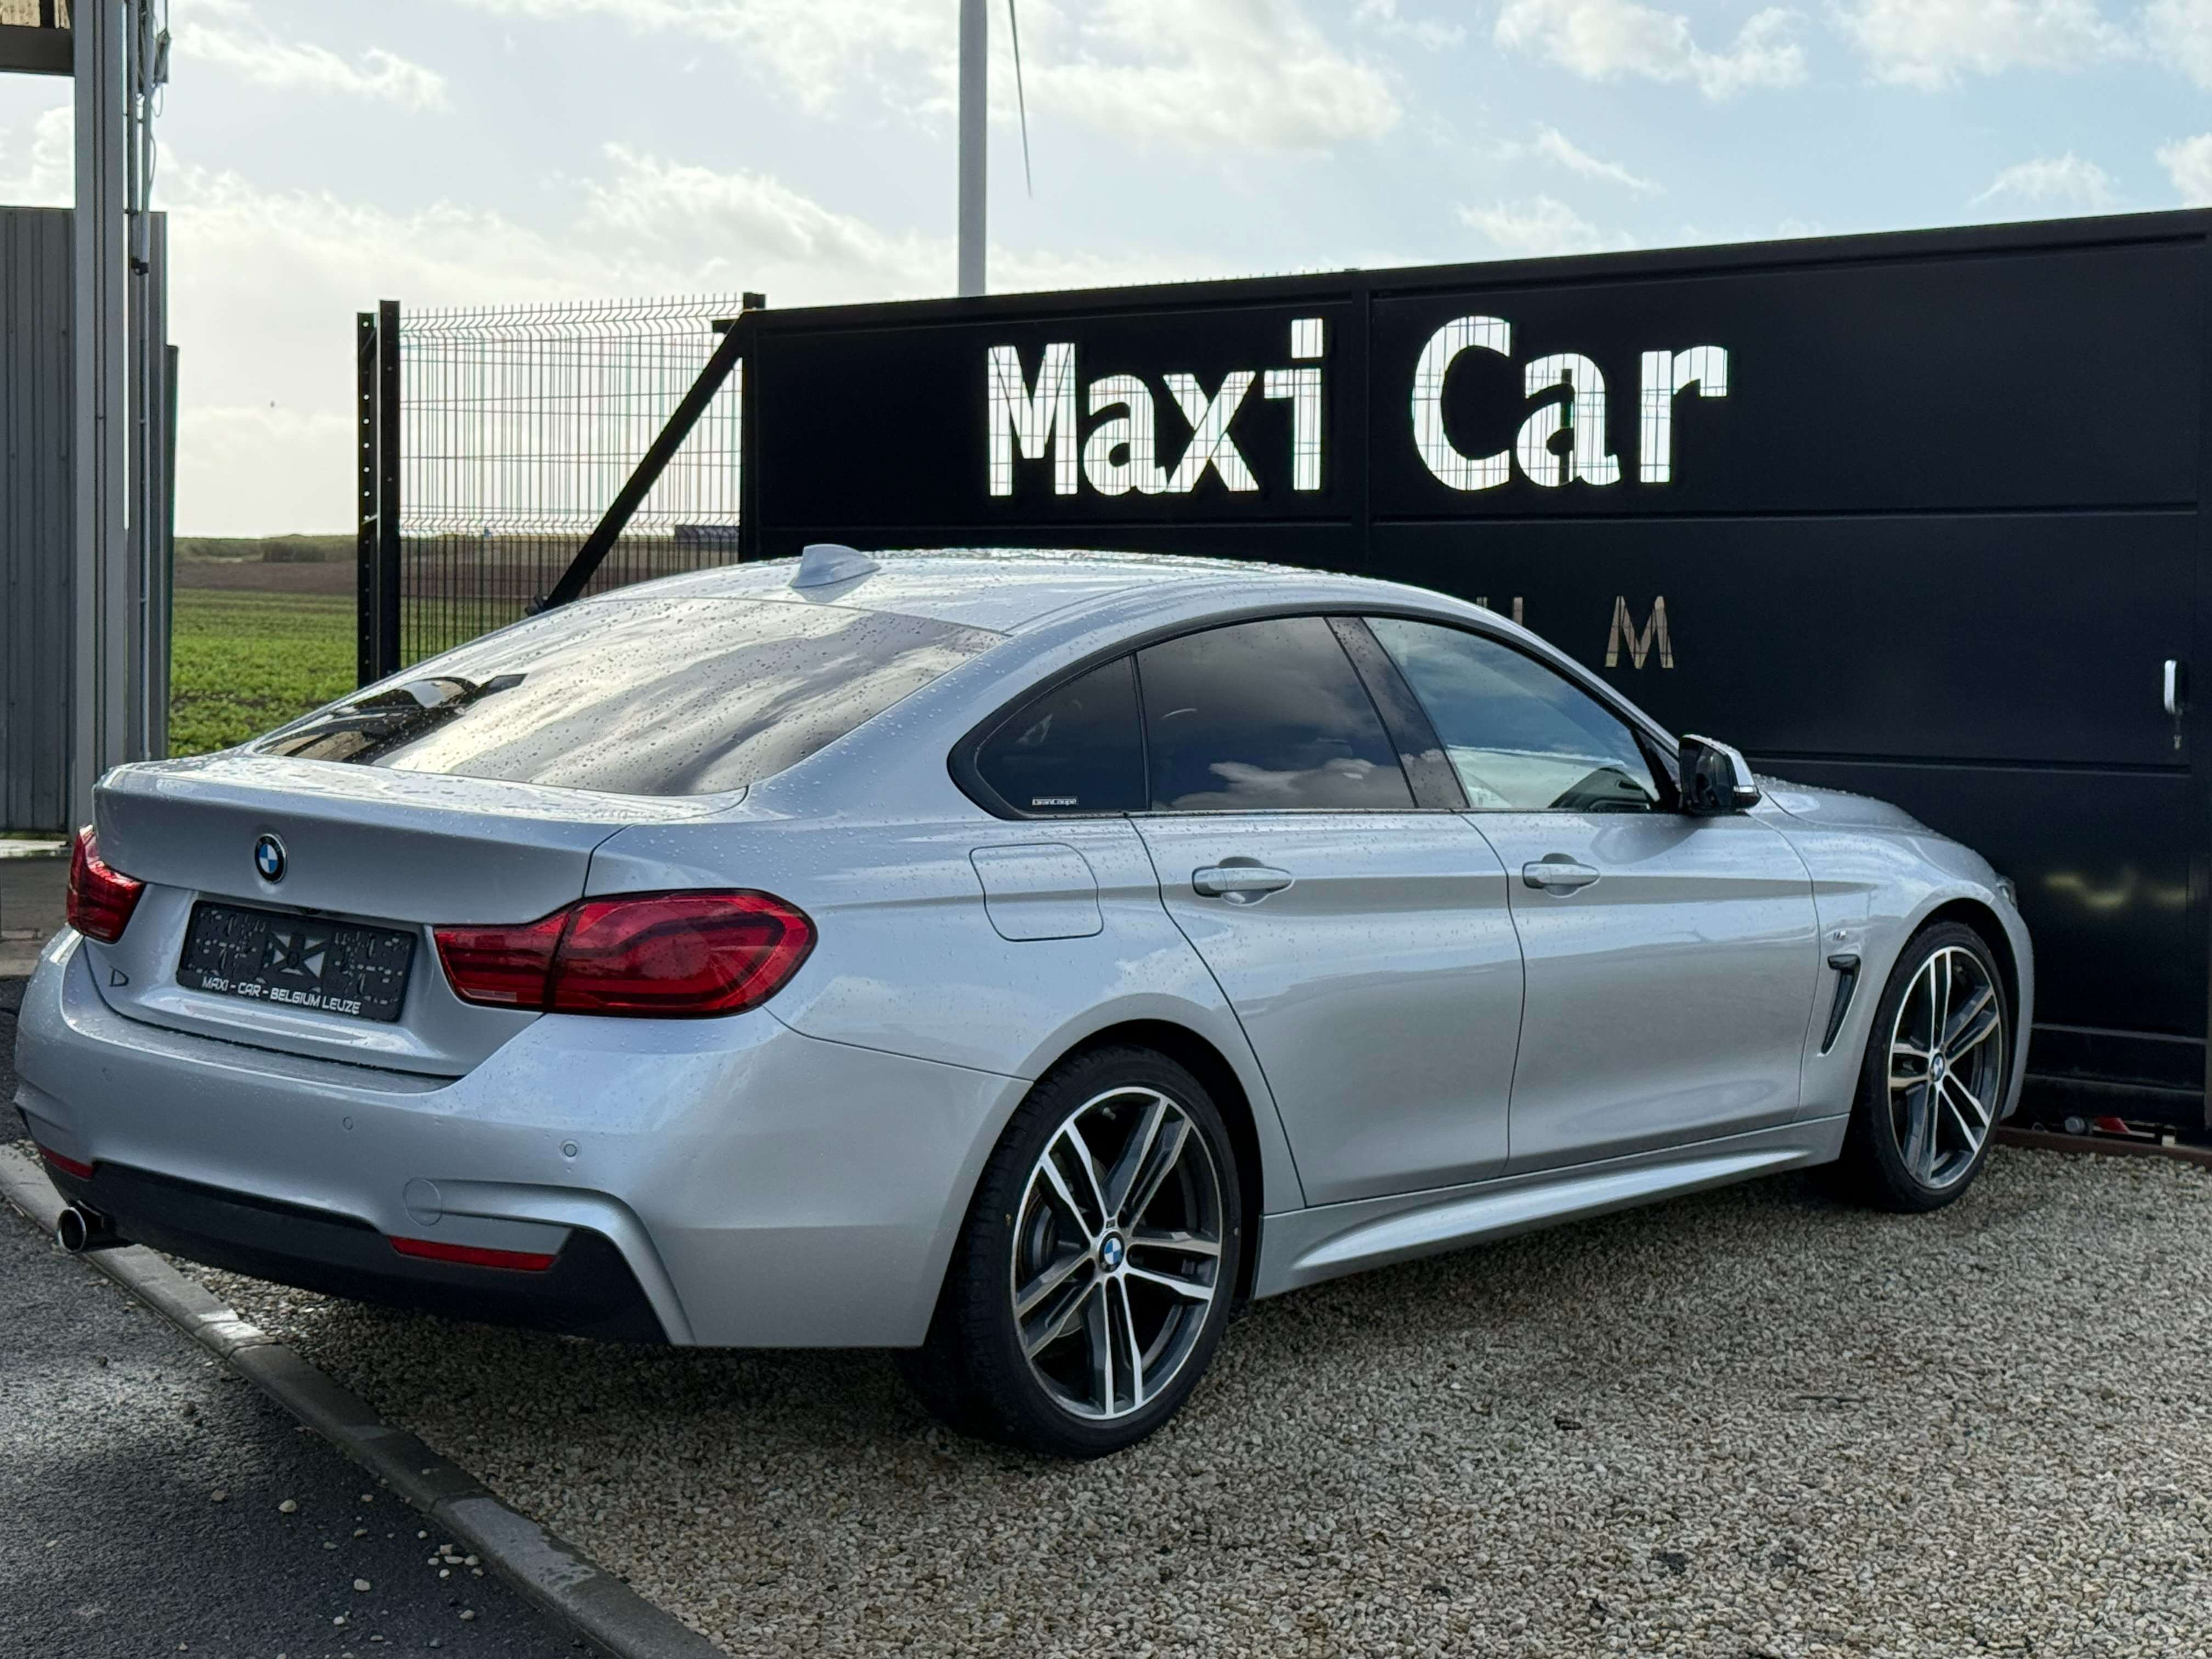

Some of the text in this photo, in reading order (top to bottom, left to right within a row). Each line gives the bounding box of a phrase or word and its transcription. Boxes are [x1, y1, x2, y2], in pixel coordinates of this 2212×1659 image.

[988, 315, 1728, 496] Maxi Car
[201, 976, 229, 992] MAXI
[238, 981, 261, 997] CAR
[270, 987, 321, 1008] BELGIUM
[321, 995, 362, 1015] LEUZE
